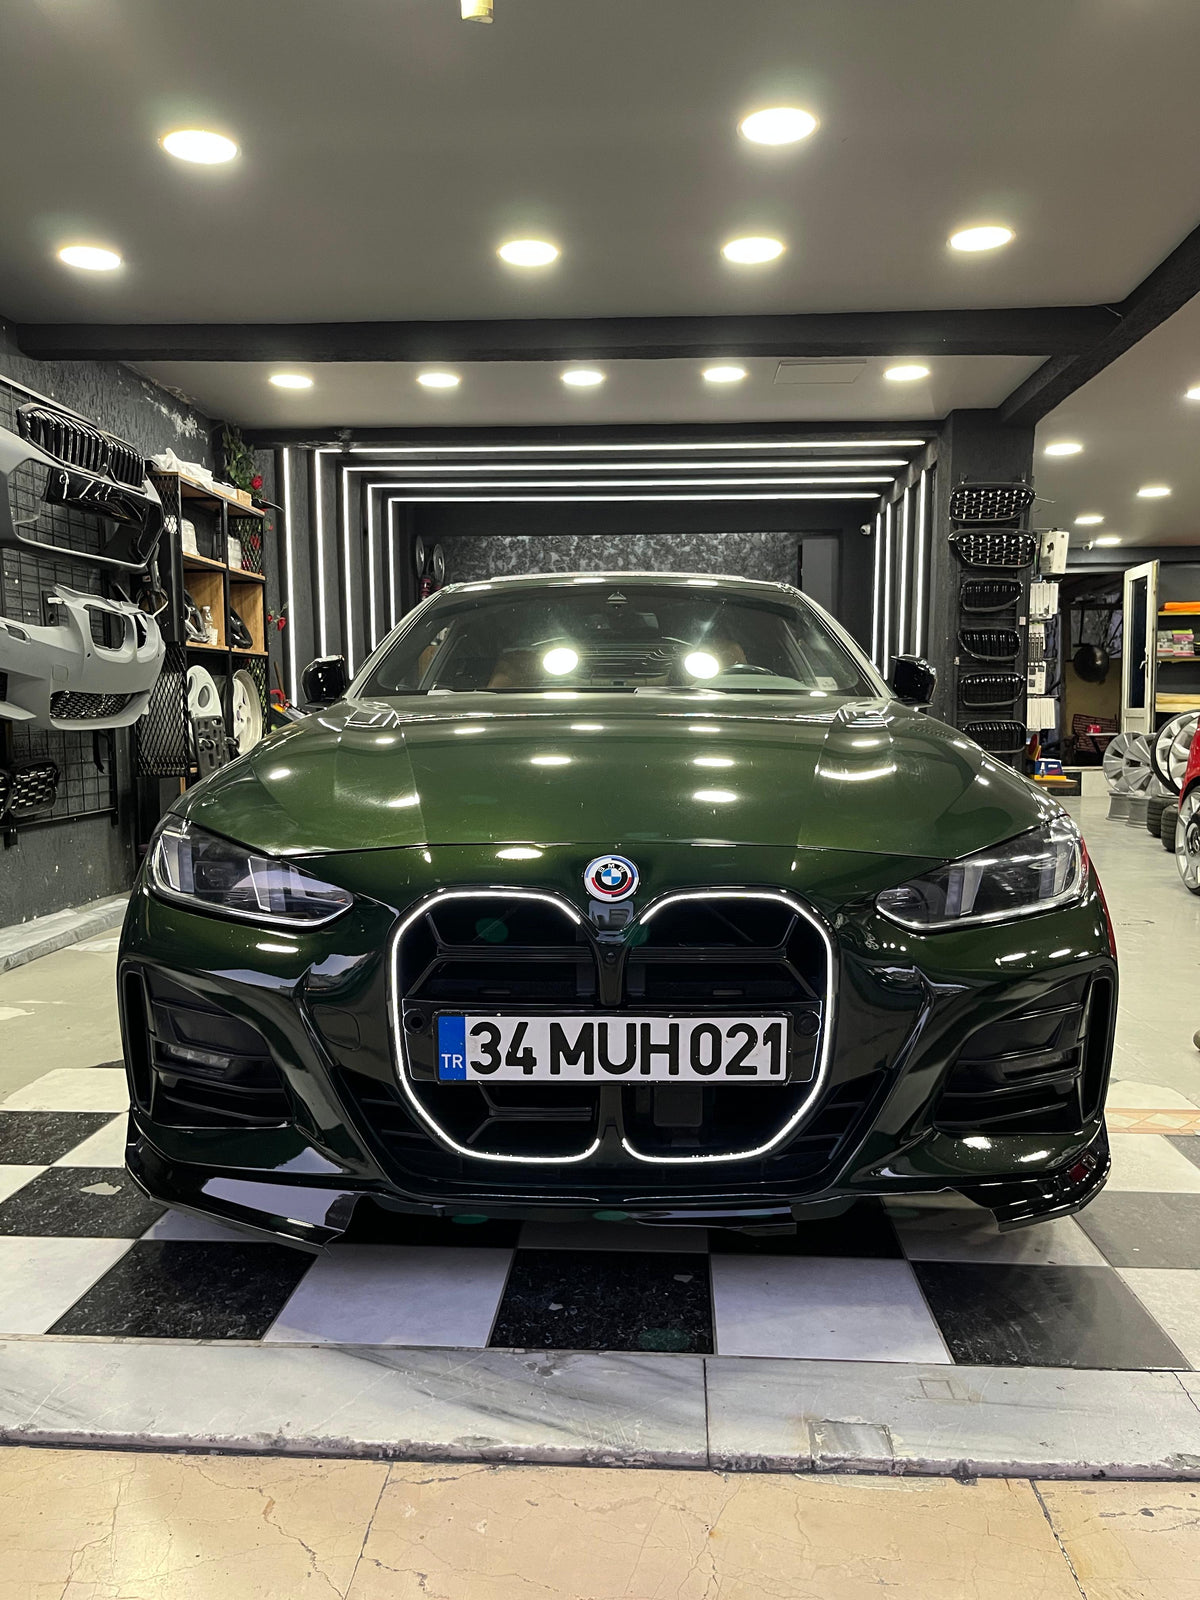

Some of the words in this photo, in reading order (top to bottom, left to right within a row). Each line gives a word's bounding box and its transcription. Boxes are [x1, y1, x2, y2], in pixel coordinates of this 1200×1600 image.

[598, 863, 626, 873] BMW
[469, 1021, 537, 1075] 34
[550, 1022, 680, 1075] MUH
[690, 1022, 782, 1075] 021
[441, 1053, 463, 1069] TR
